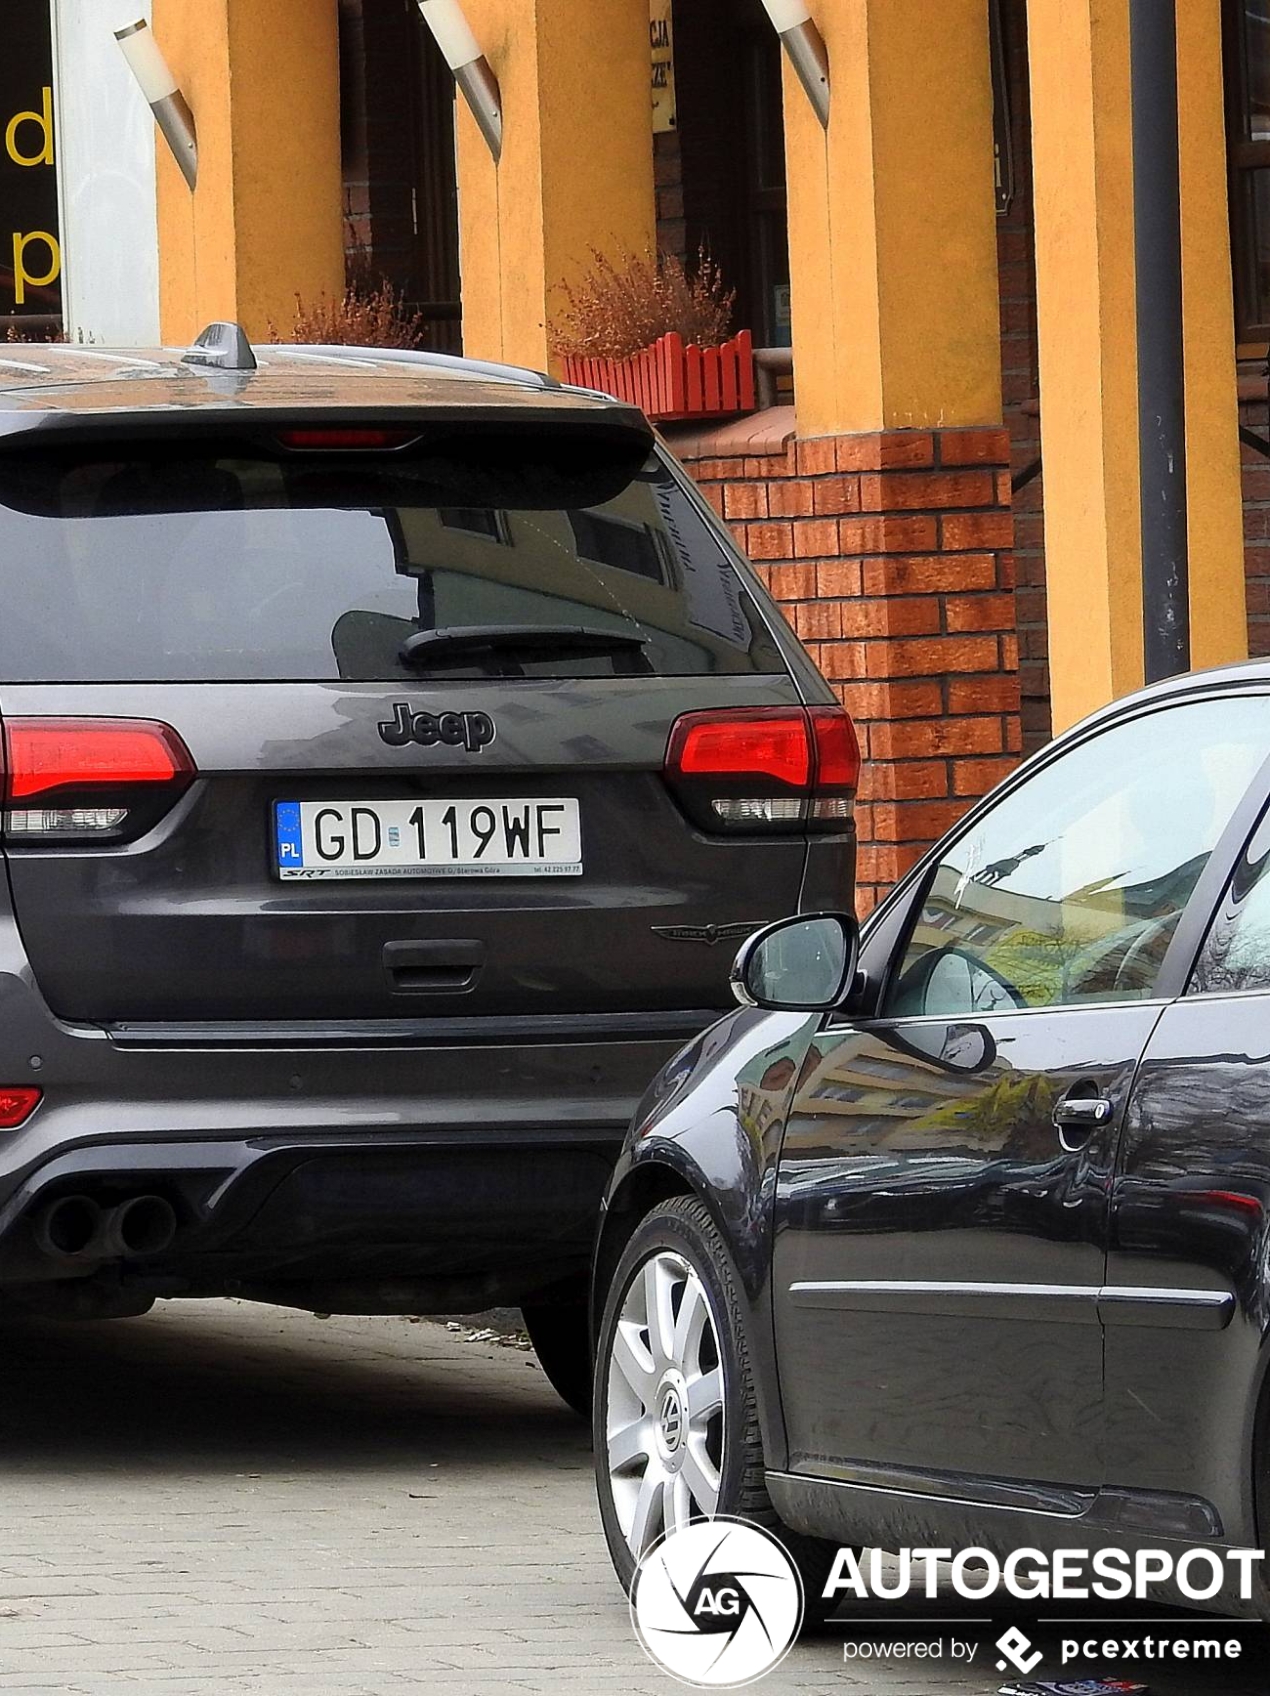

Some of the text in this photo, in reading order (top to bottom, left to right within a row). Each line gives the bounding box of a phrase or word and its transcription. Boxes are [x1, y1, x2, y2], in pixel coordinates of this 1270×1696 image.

[377, 703, 497, 753] Jeep
[314, 804, 566, 860] GD 119WF
[281, 843, 300, 859] PL
[283, 869, 331, 878] SRT
